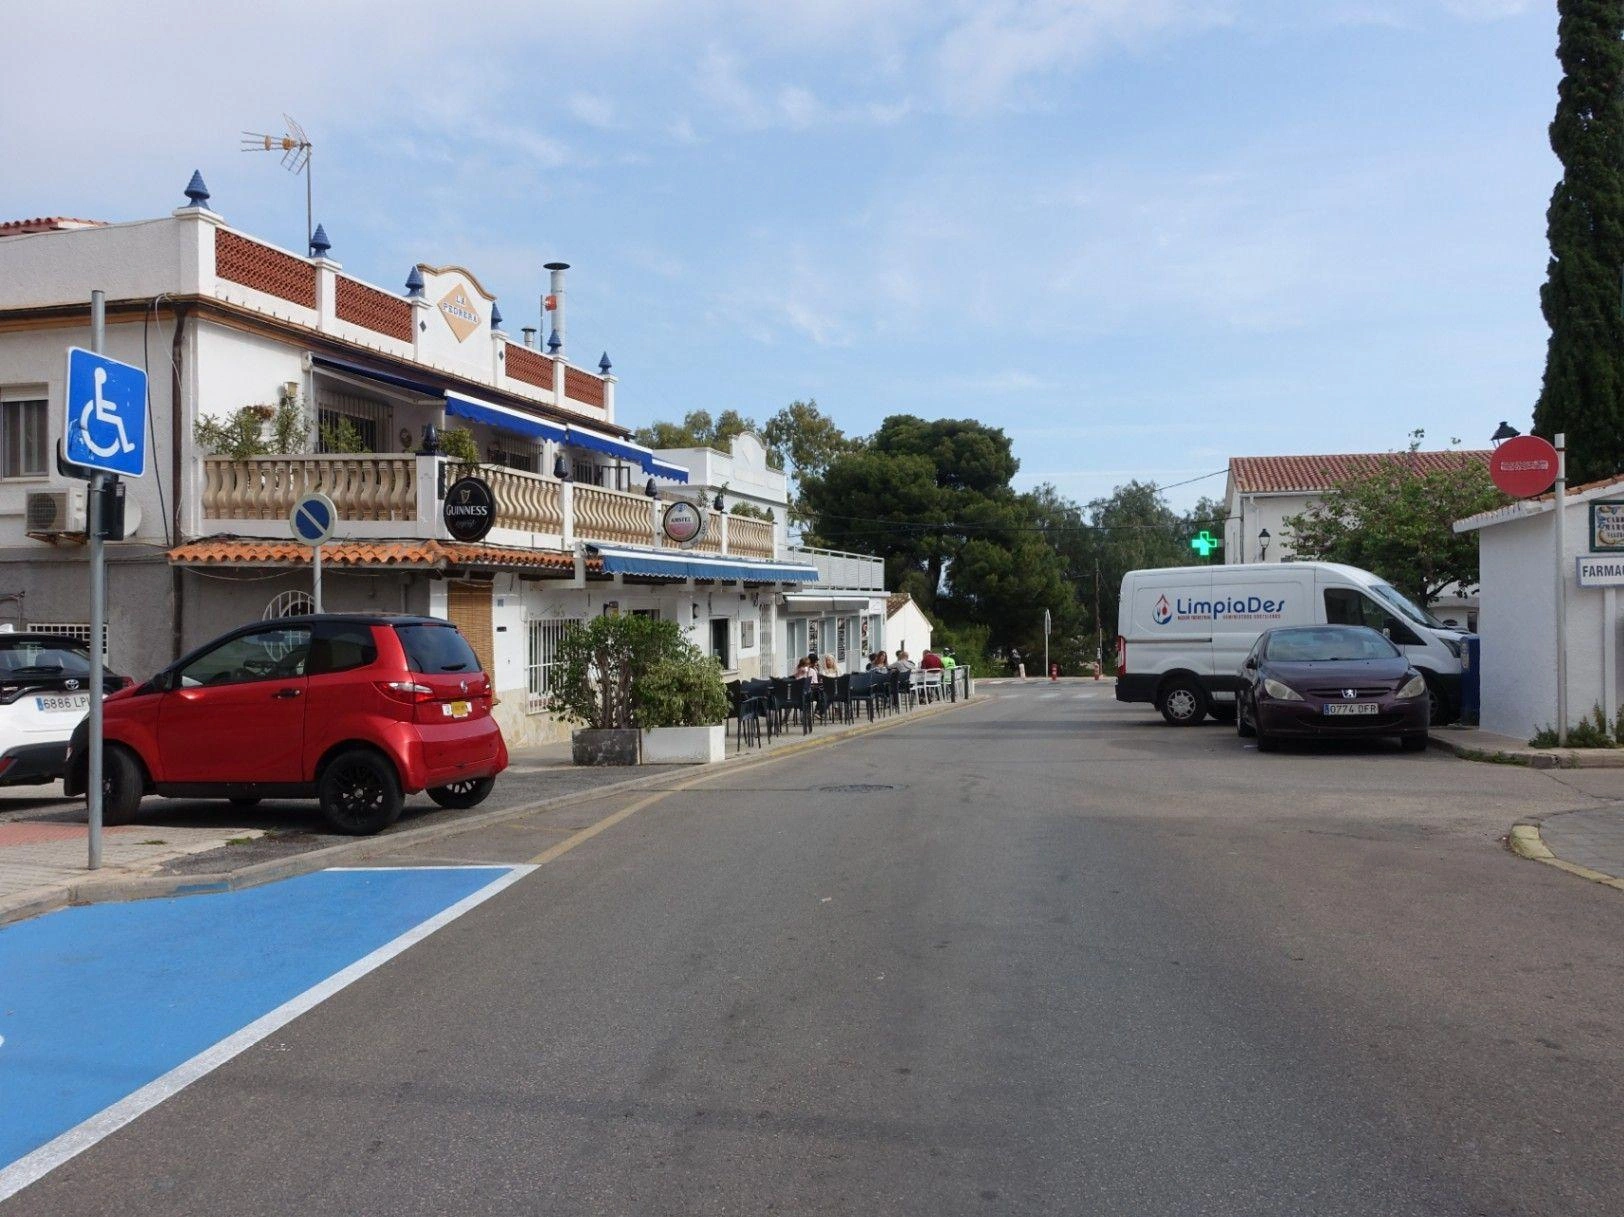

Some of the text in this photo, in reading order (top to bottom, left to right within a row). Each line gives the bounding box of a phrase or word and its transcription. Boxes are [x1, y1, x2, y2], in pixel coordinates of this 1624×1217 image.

[446, 504, 488, 516] GUINNESS
[1177, 596, 1285, 619] LimpiaDes
[43, 696, 90, 709] 6886 LP
[1330, 705, 1354, 713] 0774
